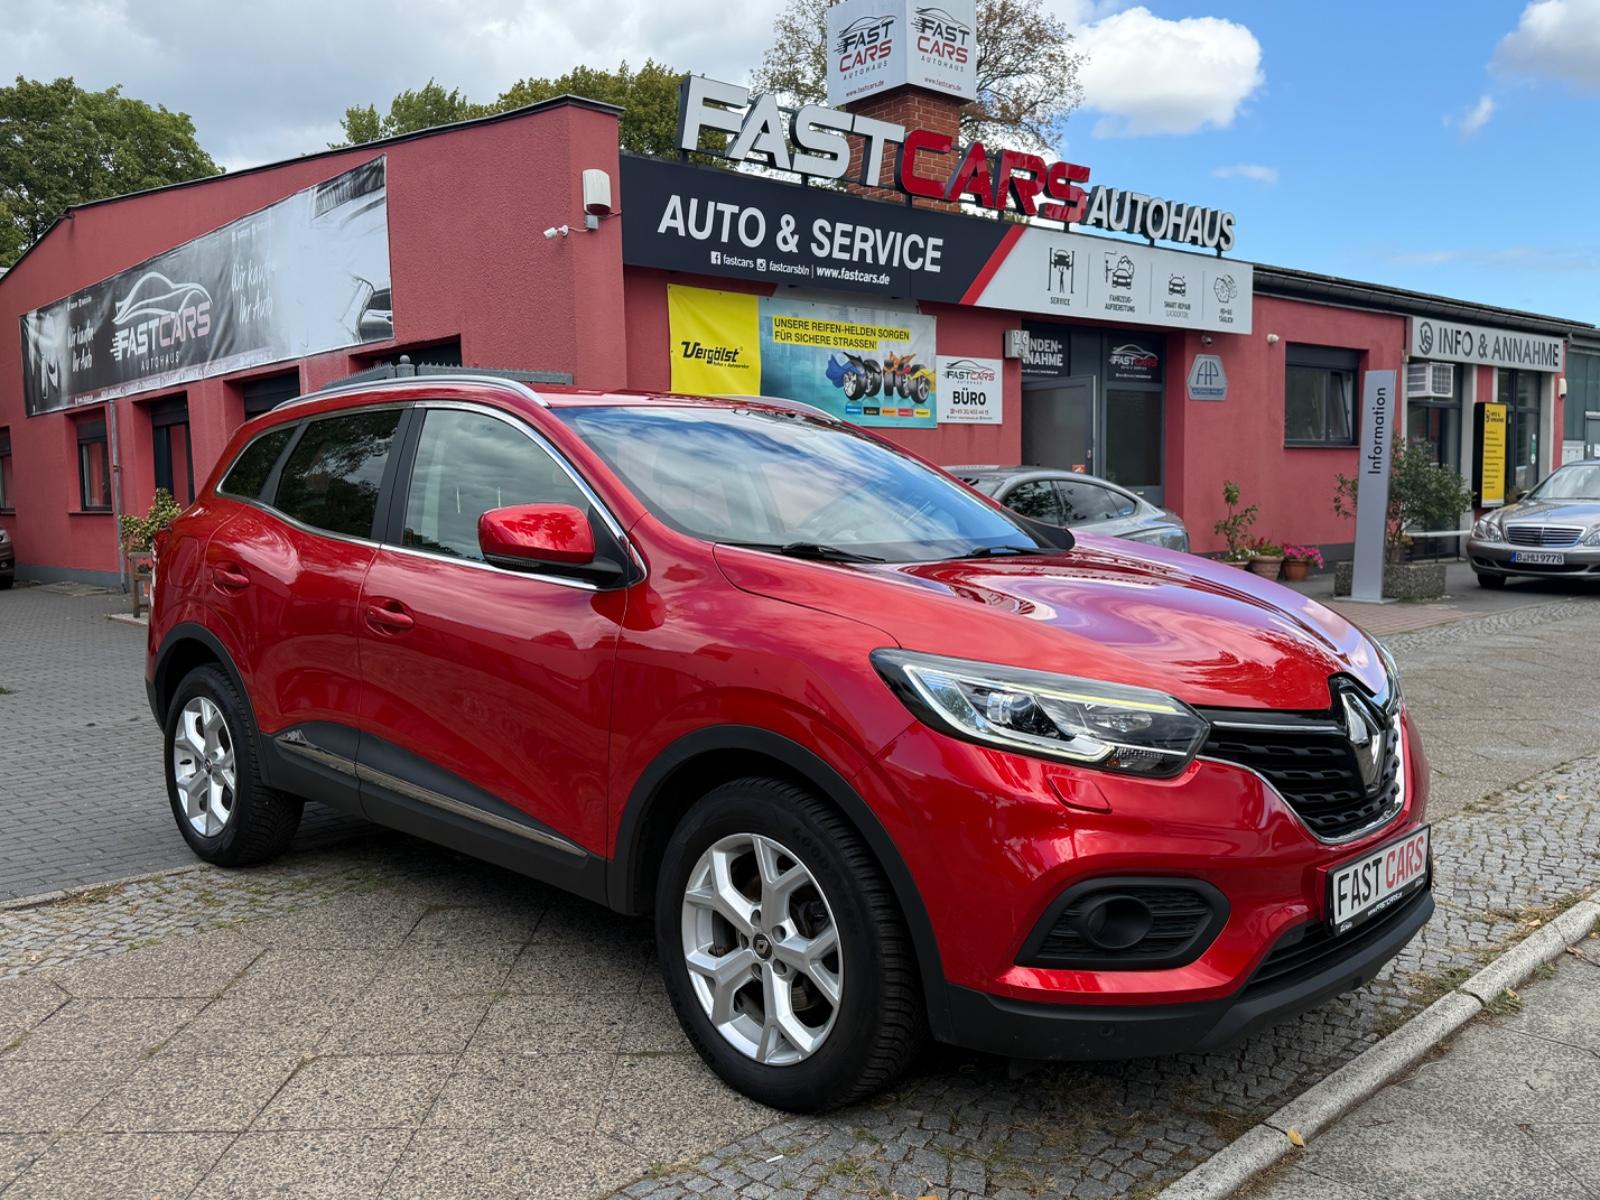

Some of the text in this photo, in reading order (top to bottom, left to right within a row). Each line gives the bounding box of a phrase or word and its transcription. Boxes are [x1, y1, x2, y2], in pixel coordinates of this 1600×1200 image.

[838, 20, 894, 53] FAST
[917, 17, 970, 46] FAST
[840, 39, 892, 72] CARS
[917, 36, 968, 64] CARS
[843, 60, 888, 80] AUTOHAUS
[921, 56, 964, 73] AUTOHAUS
[1086, 185, 1235, 251] AUTOHAUS
[657, 195, 944, 273] AUTO & SERVICE
[723, 254, 754, 268] fastcars
[816, 266, 890, 285] www.fastcars.de
[774, 318, 910, 340] UNSERE REIFEN-HELDEN SORGEN
[774, 330, 877, 349] FÜR SICHERE STRASSEN!
[681, 341, 739, 364] Vergölst
[1030, 338, 1063, 353] NDEN-
[1438, 327, 1473, 358] INFO
[1477, 333, 1488, 359] &
[1491, 336, 1559, 367] ANNAHME
[141, 351, 180, 371] AUTOHAUS
[1023, 352, 1064, 366] NAHME
[952, 387, 986, 406] BÜRO
[1367, 387, 1386, 474] Information
